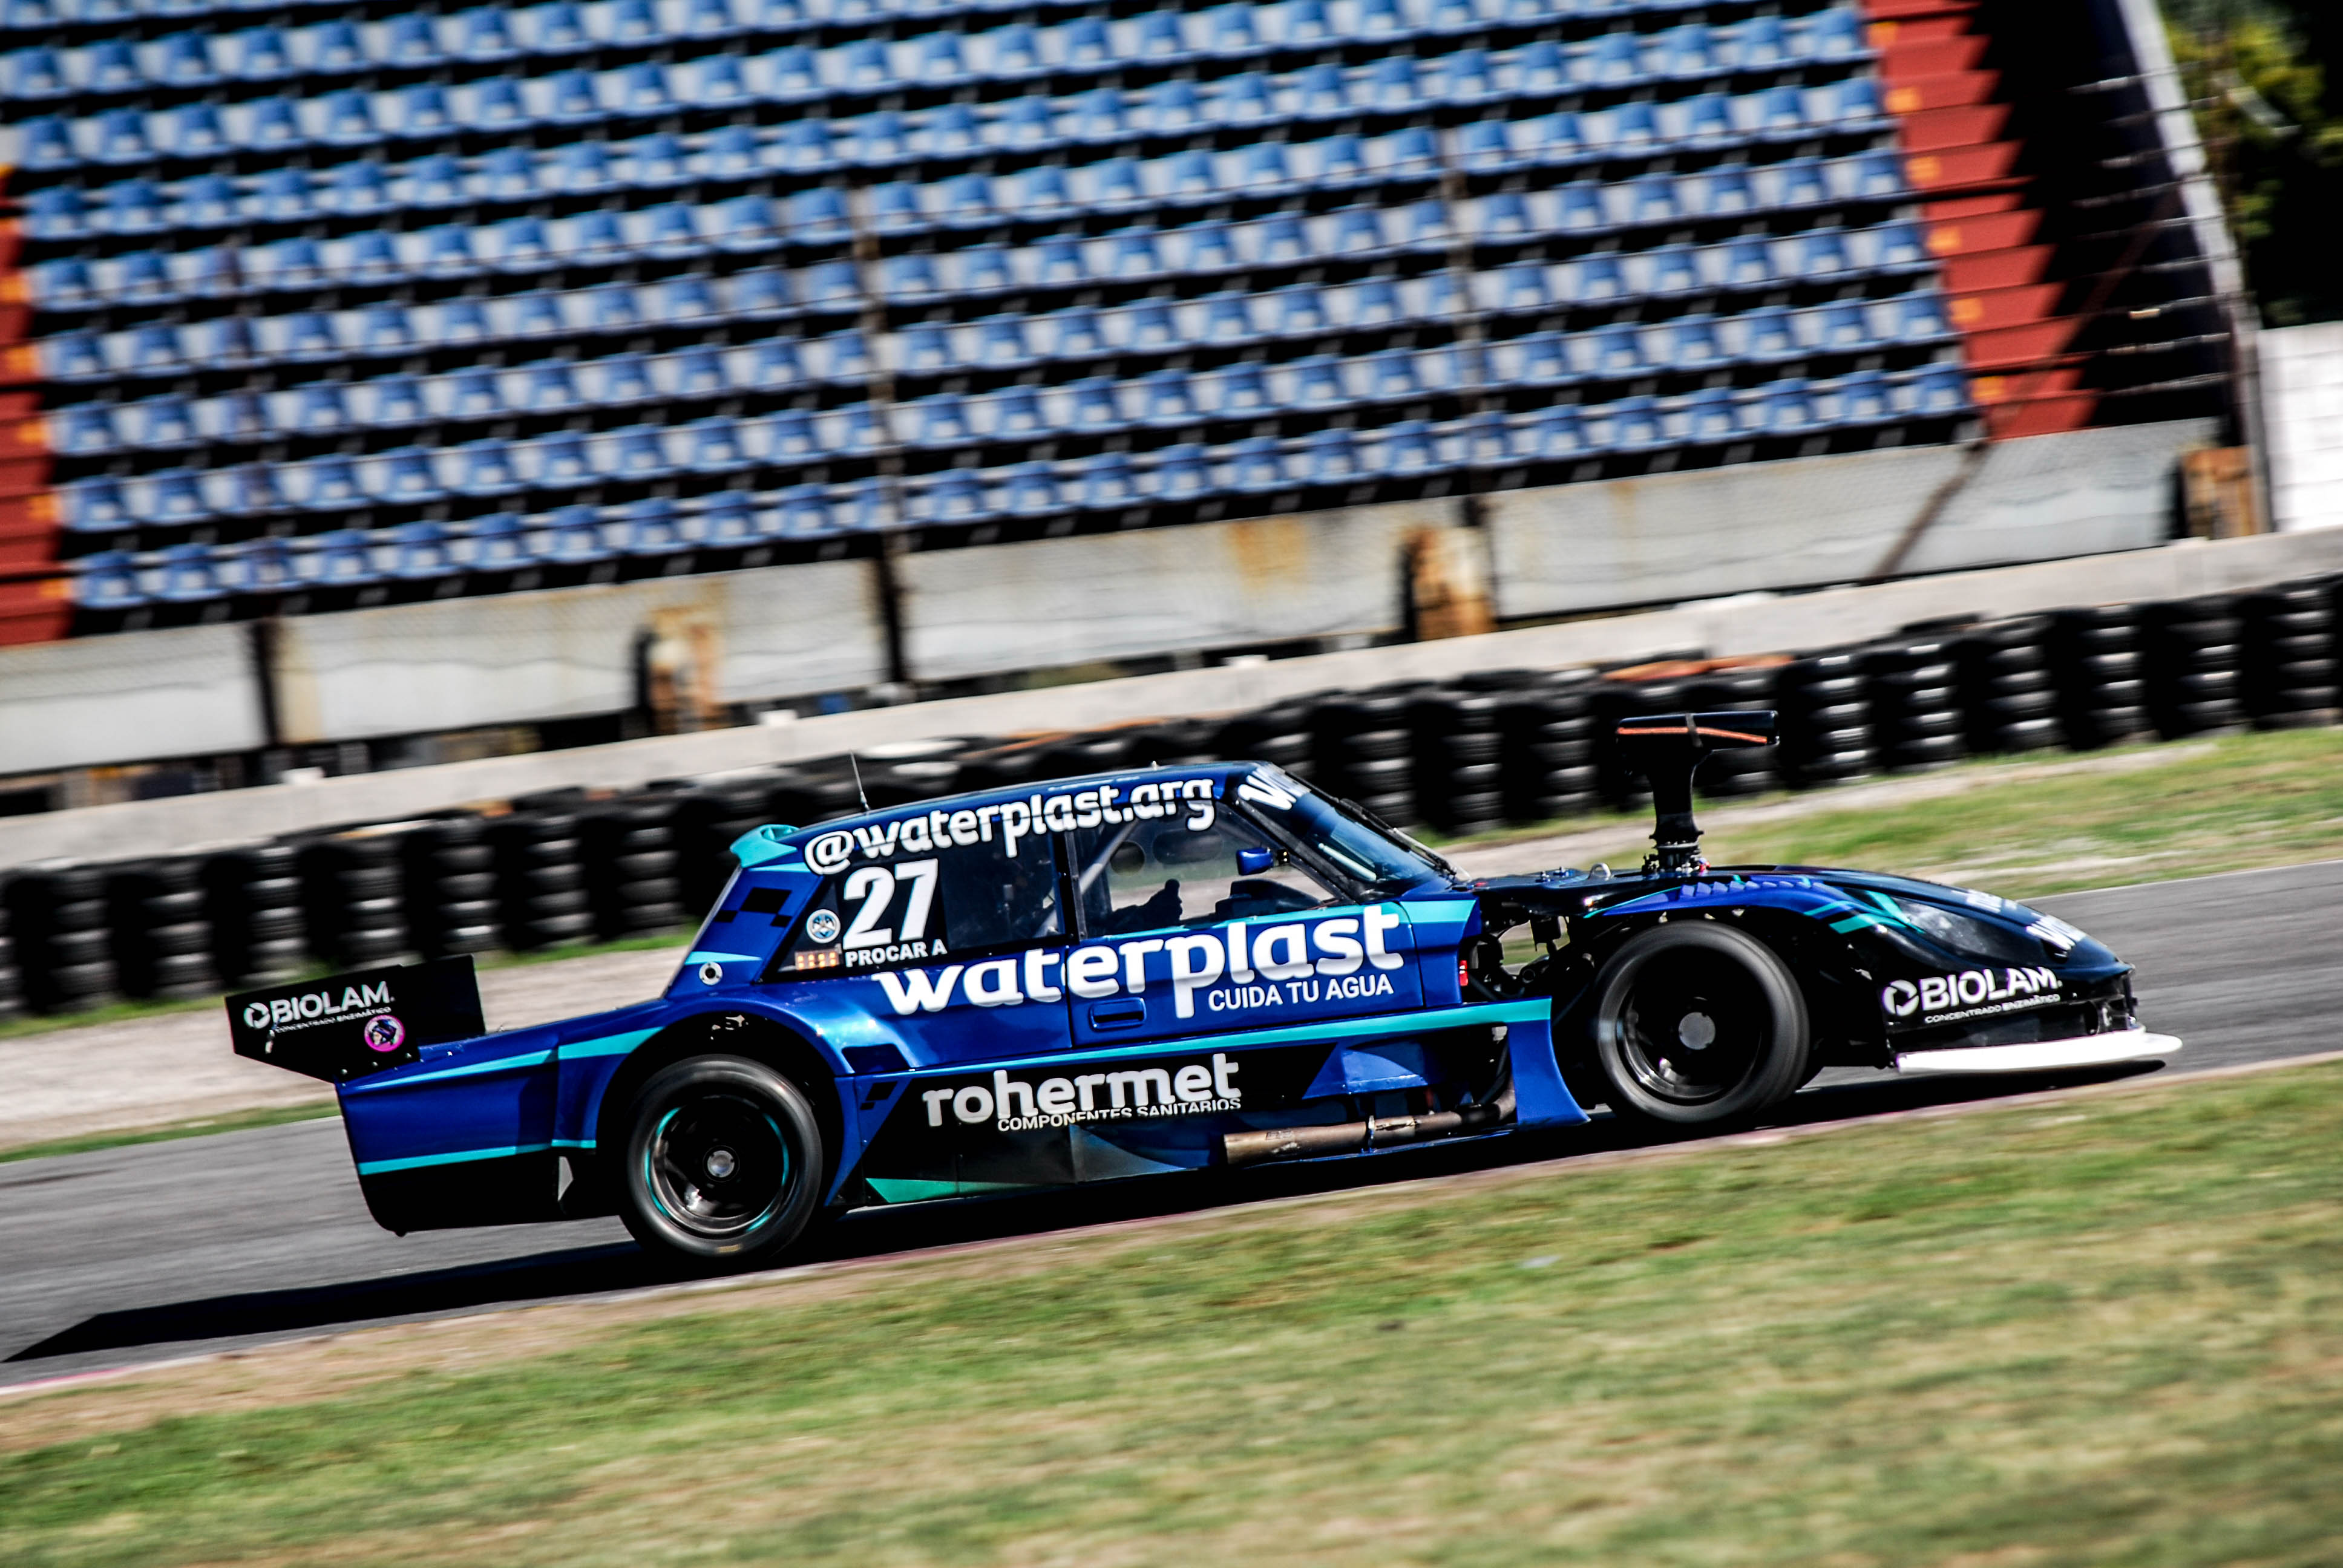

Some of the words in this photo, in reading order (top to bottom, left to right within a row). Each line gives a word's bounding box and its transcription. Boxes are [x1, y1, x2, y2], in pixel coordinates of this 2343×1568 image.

[804, 778, 1214, 875] @waterplast.arg
[842, 858, 939, 950] 27
[844, 941, 928, 968] PROCAR
[932, 938, 948, 956] A
[870, 904, 1404, 1019] waterplast
[270, 981, 391, 1024] BIOLAM
[1208, 984, 1283, 1011] CUIDA
[1286, 979, 1319, 1004] TU
[1325, 973, 1394, 1001] AGUA
[1919, 966, 2059, 1011] BIOLAM
[1924, 1005, 2002, 1024] CONCENTRADO
[923, 1053, 1241, 1127] rohermet
[997, 1108, 1132, 1132] COMPONENTES
[1136, 1097, 1241, 1118] SANITARIOS
